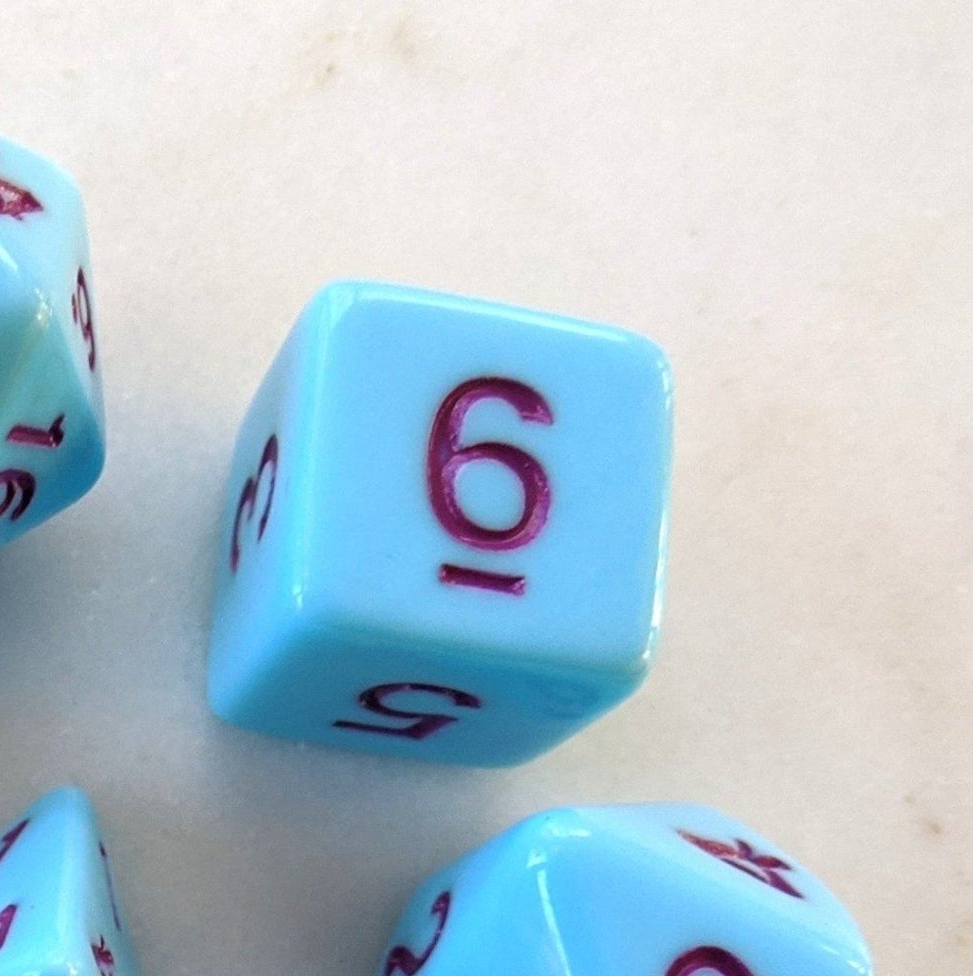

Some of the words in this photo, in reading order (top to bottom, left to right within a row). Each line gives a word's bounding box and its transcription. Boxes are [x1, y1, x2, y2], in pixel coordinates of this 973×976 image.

[230, 433, 278, 575] 3
[425, 375, 555, 597] 6
[330, 681, 483, 741] 5
